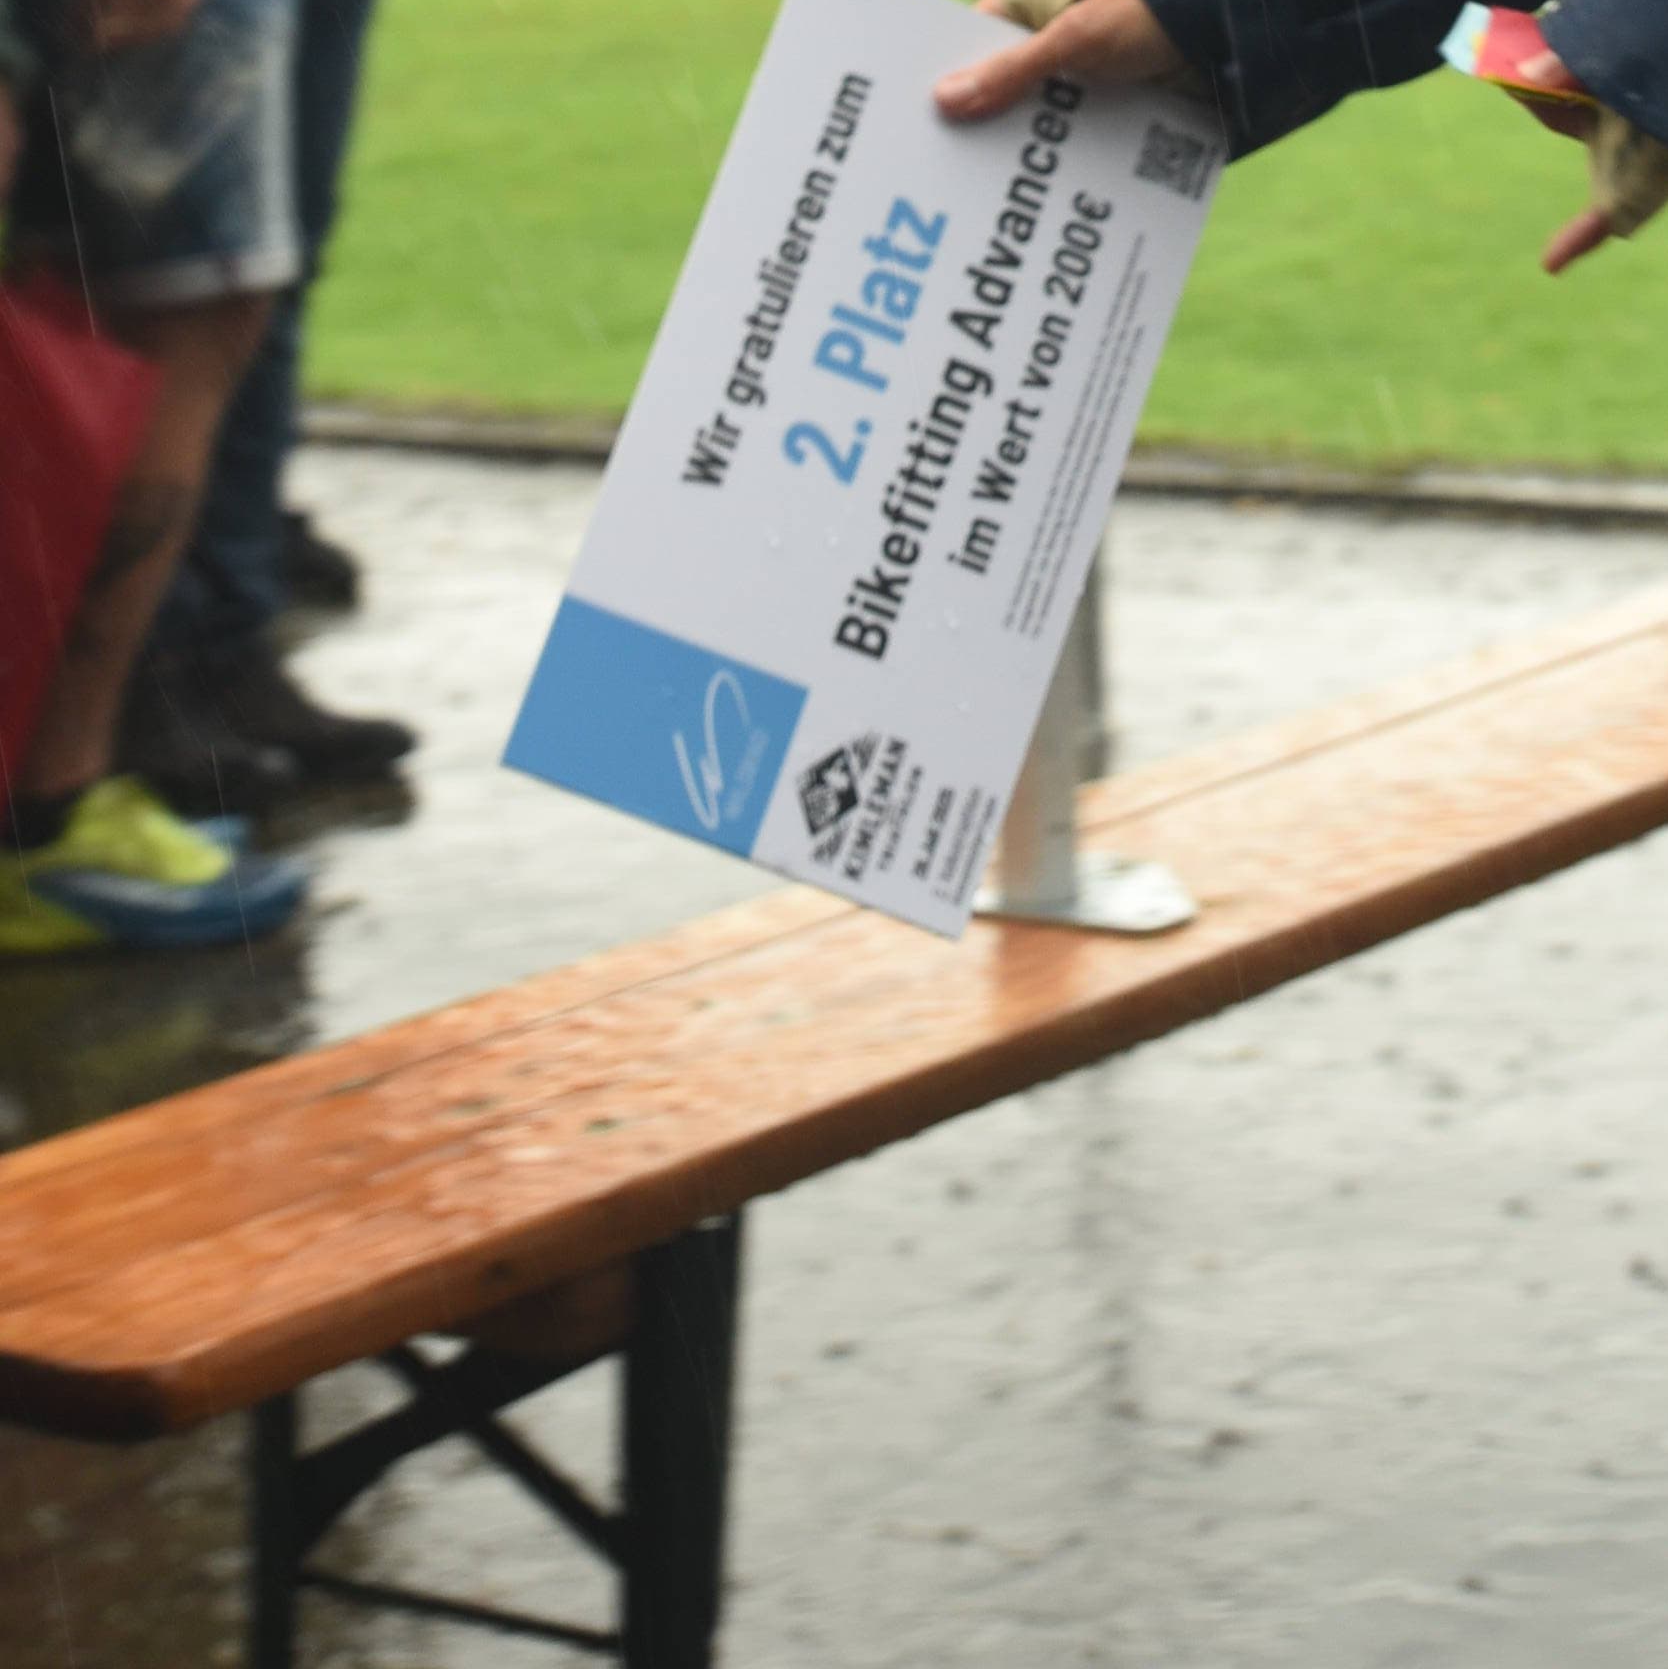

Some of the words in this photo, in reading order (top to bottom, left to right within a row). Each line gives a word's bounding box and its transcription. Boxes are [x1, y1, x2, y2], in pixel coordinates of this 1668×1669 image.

[682, 412, 740, 484] Wir
[726, 169, 835, 406] gratulieren
[816, 73, 870, 163] zum
[814, 197, 947, 393] Platz
[1043, 192, 1111, 306] 200€
[1021, 313, 1071, 388] von
[782, 419, 872, 484] 2.
[971, 399, 1041, 501] Wert
[834, 358, 993, 660] Bikefitting
[947, 518, 1000, 573] im
